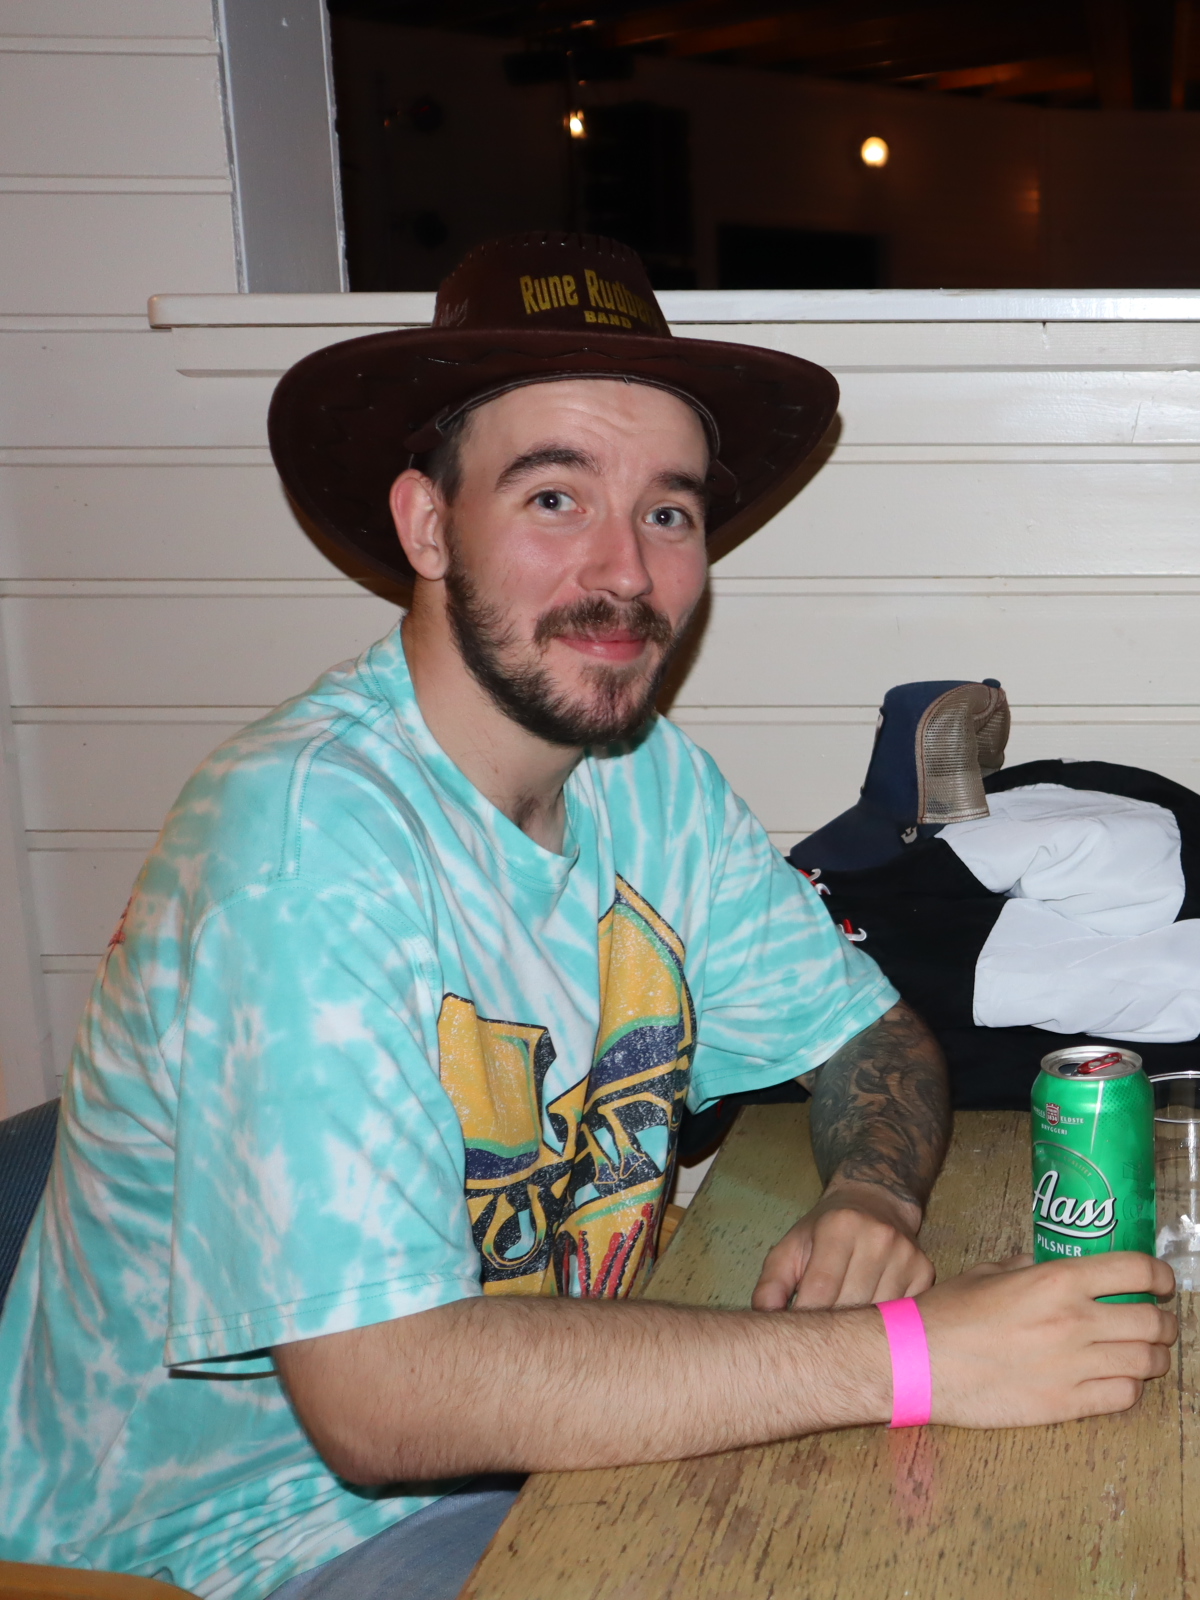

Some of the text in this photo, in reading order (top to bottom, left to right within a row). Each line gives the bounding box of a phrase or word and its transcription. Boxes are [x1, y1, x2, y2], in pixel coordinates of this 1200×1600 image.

[519, 274, 579, 315] Rune
[584, 269, 660, 334] Rudber
[583, 310, 633, 329] BAND
[1060, 1115, 1084, 1124] ELDSTE
[1032, 1170, 1117, 1229] Aass
[1036, 1233, 1082, 1257] PILSNER
